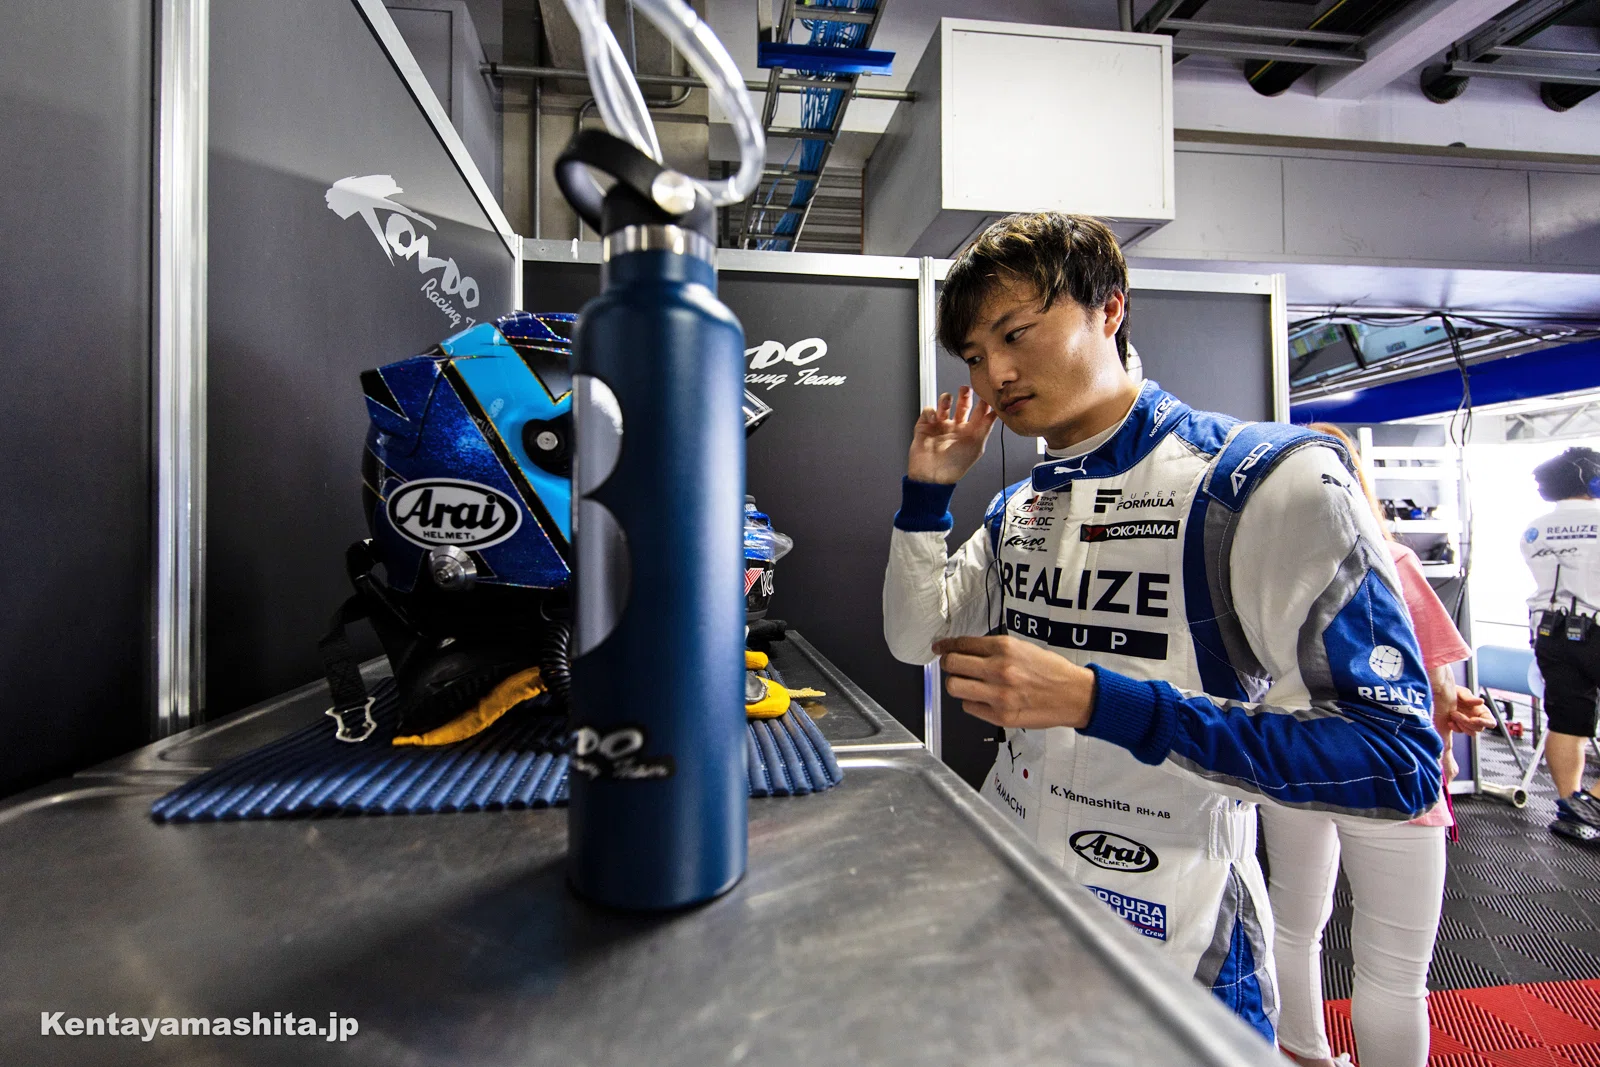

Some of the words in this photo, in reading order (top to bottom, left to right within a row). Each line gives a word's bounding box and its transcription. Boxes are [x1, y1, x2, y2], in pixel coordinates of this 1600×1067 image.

[420, 278, 462, 328] Racing
[744, 373, 788, 390] cing
[793, 367, 847, 386] Team
[1116, 498, 1175, 511] FORMULA
[1120, 490, 1177, 501] SUPER
[396, 488, 500, 530] Arai
[423, 530, 471, 540] HELMET
[1106, 524, 1175, 538] YOKOHAMA
[1546, 525, 1598, 534] REALIZE
[1000, 559, 1170, 618] REALIZE
[1014, 614, 1128, 650] GRUP
[1051, 785, 1130, 812] K.Yamashita
[1075, 834, 1147, 865] Arai
[1094, 856, 1126, 868] HELMET
[1097, 890, 1164, 918] OGURA
[1115, 906, 1164, 929] UTCH
